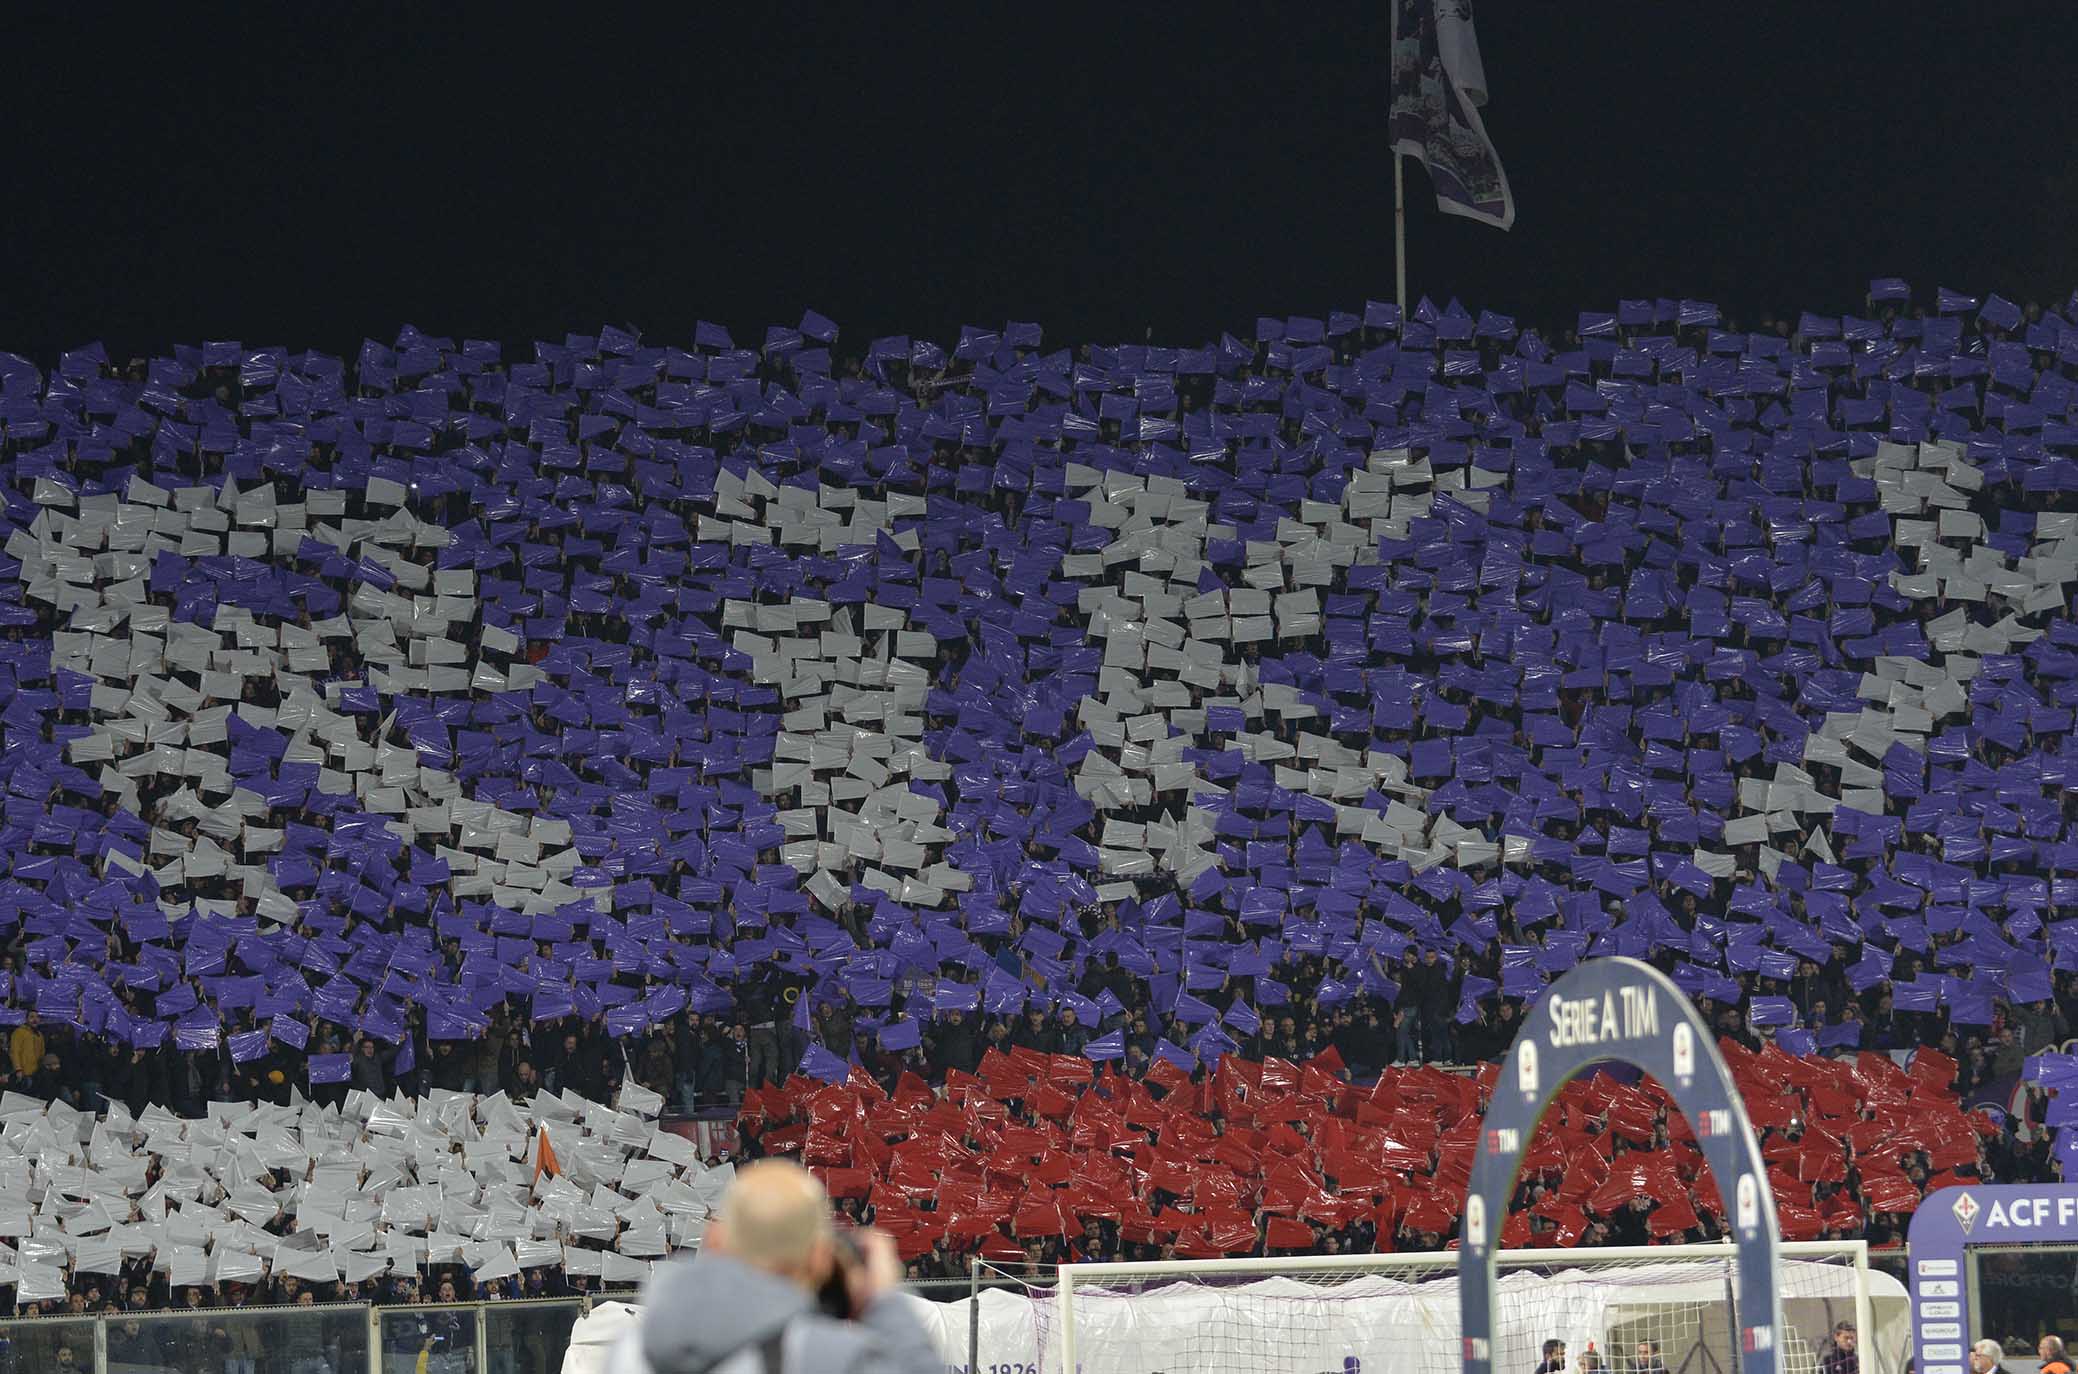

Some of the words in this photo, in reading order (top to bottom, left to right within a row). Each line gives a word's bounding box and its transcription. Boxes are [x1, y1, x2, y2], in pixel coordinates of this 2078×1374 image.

[1600, 990, 1620, 1042] A
[1620, 984, 1660, 1039] TIM
[1709, 1109, 1732, 1137] TIM
[1497, 1128, 1520, 1154] TIM
[1985, 1198, 2051, 1228] ACF
